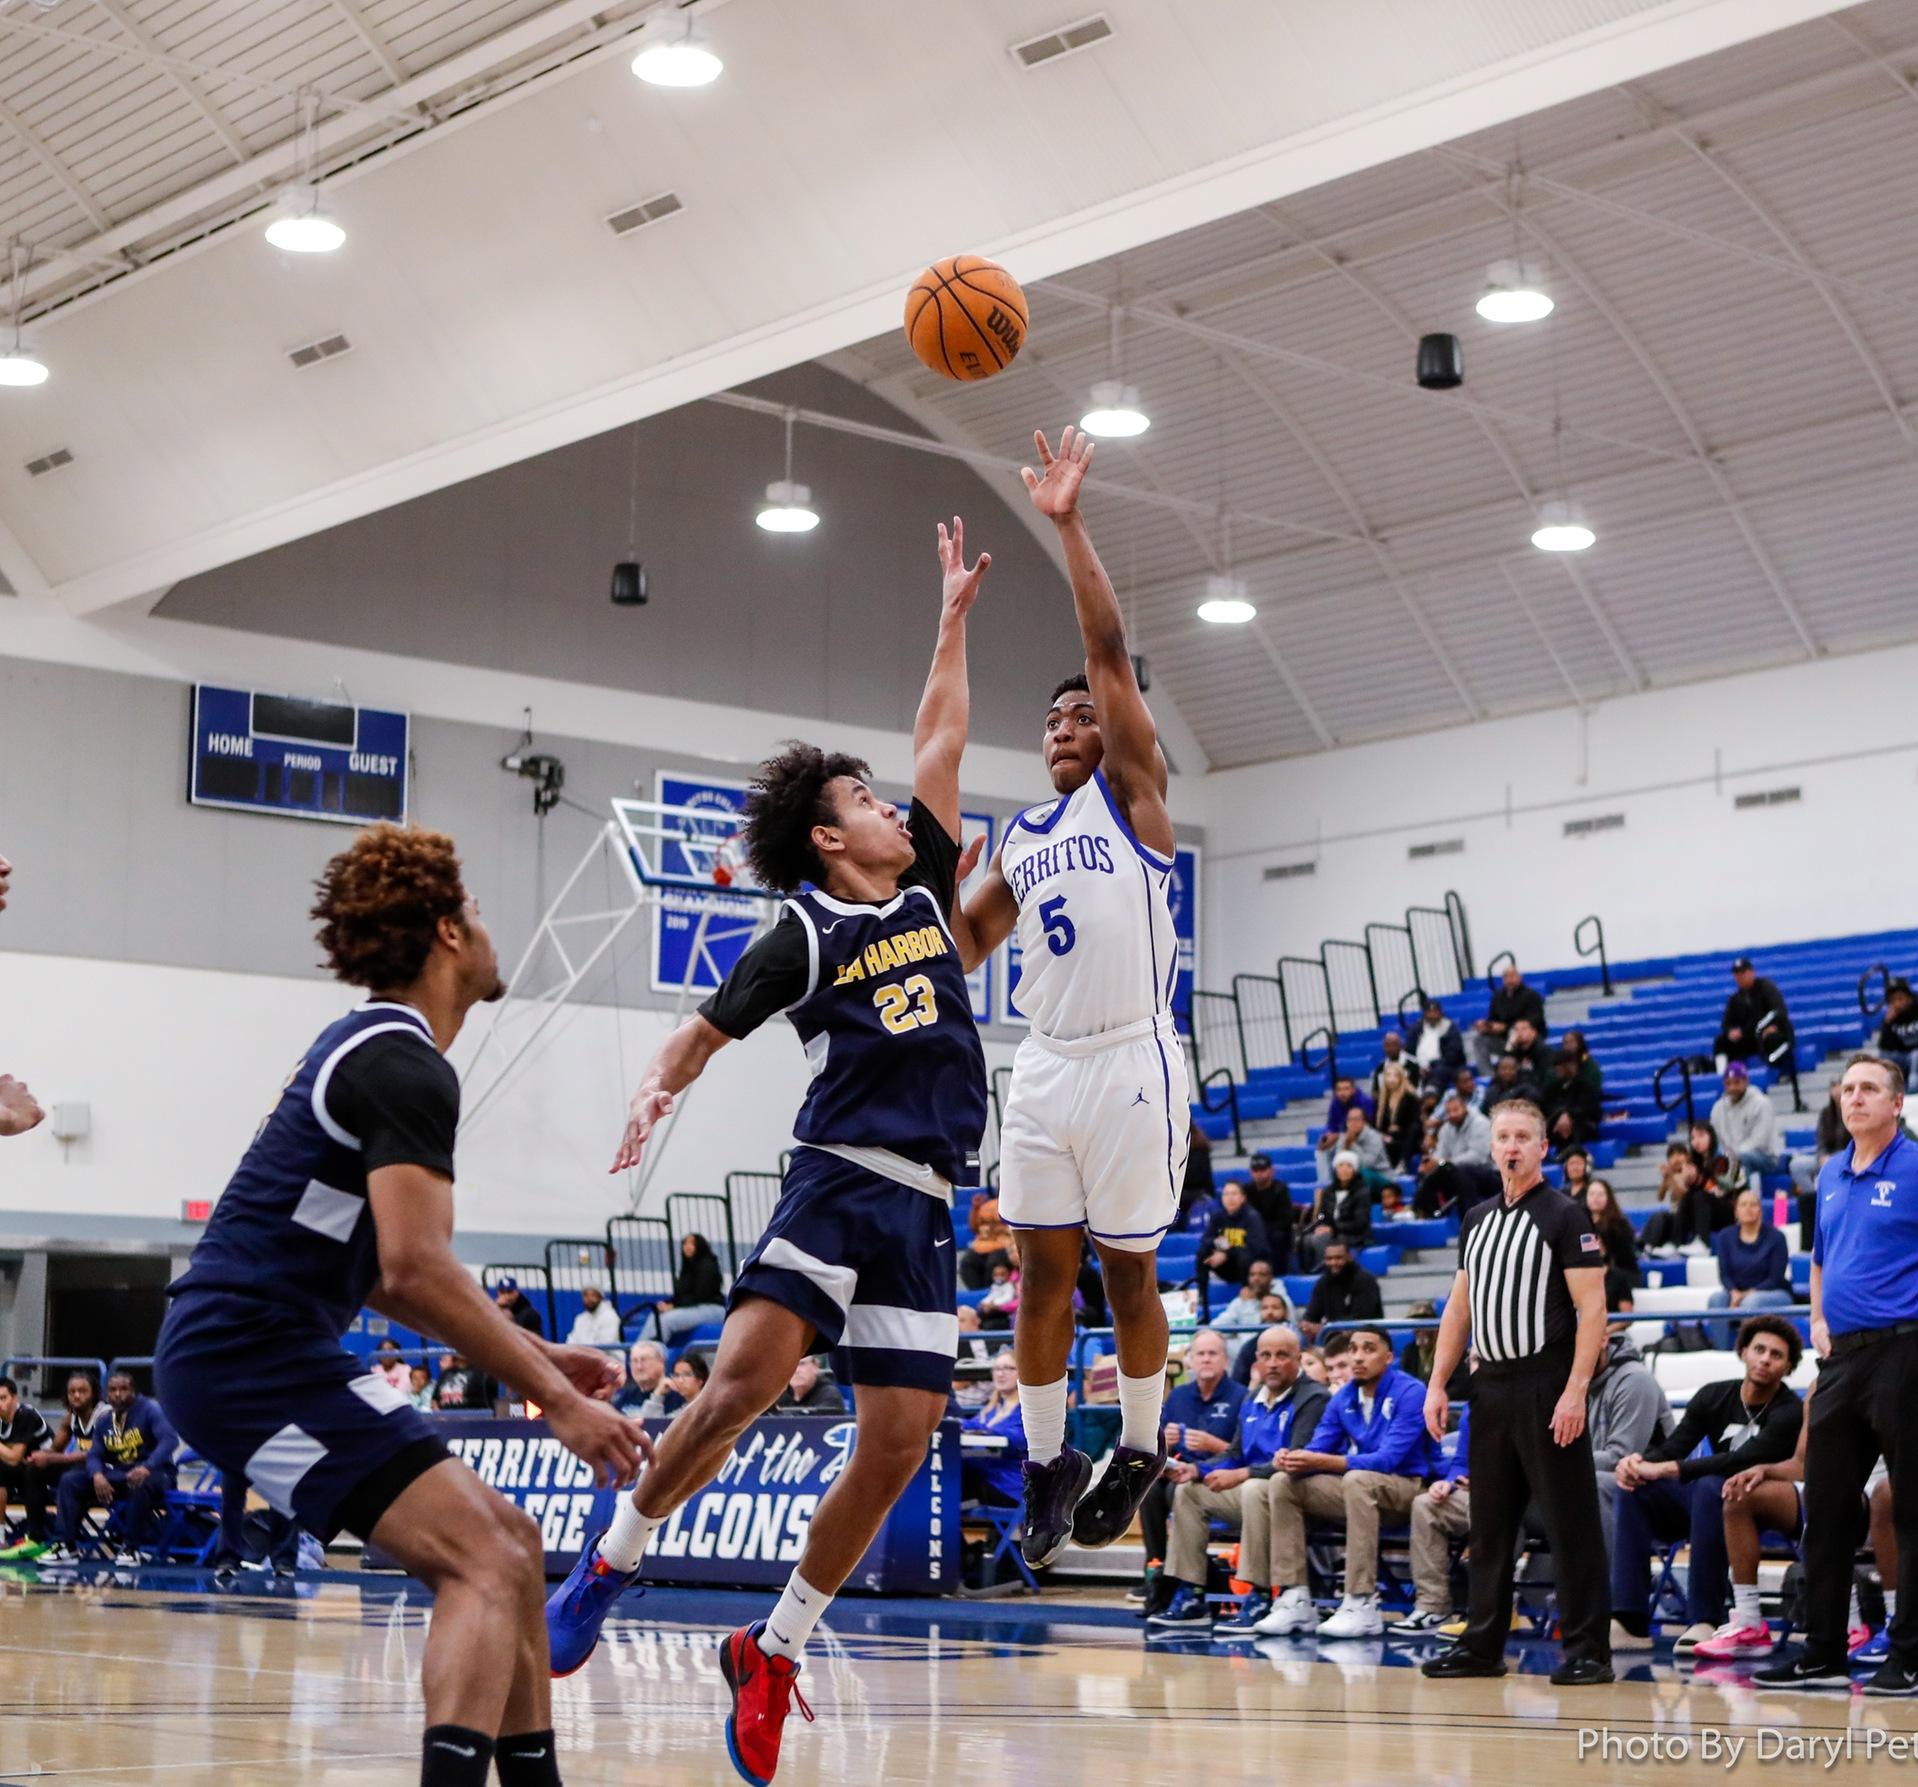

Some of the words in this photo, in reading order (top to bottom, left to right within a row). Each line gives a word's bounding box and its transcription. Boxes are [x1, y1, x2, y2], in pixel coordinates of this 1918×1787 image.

[208, 732, 254, 758] HOME
[283, 752, 322, 772] PERIOD
[348, 751, 398, 777] GUEST
[1011, 834, 1115, 901] ERRITOS
[864, 925, 949, 977] HARBOR
[1038, 894, 1076, 957] 5
[872, 973, 939, 1035] 23
[614, 1490, 819, 1562] LCONS
[929, 1432, 944, 1580] FALCONS
